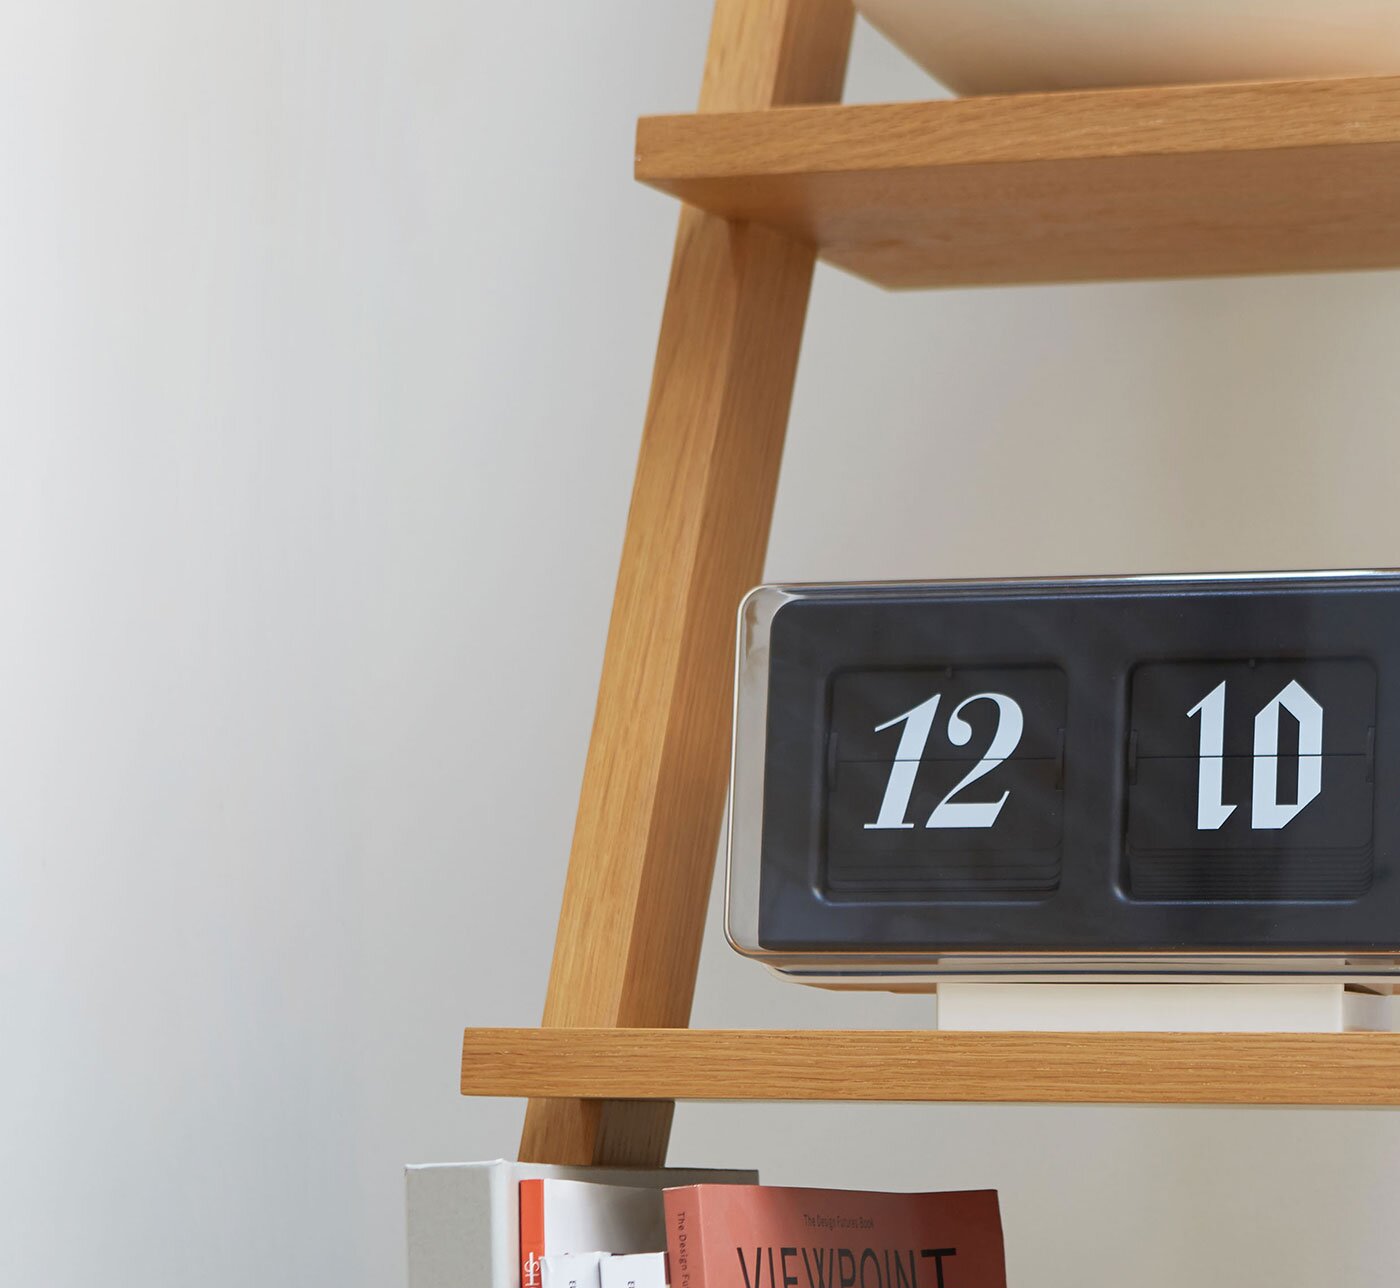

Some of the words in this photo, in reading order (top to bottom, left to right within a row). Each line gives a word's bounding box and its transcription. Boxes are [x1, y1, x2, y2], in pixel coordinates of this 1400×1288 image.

[863, 691, 1025, 830] 12
[1185, 679, 1324, 830] 10
[677, 1211, 686, 1231] The
[803, 1214, 816, 1228] The
[816, 1215, 836, 1231] Design
[859, 1216, 875, 1229] Book
[679, 1234, 689, 1271] Design
